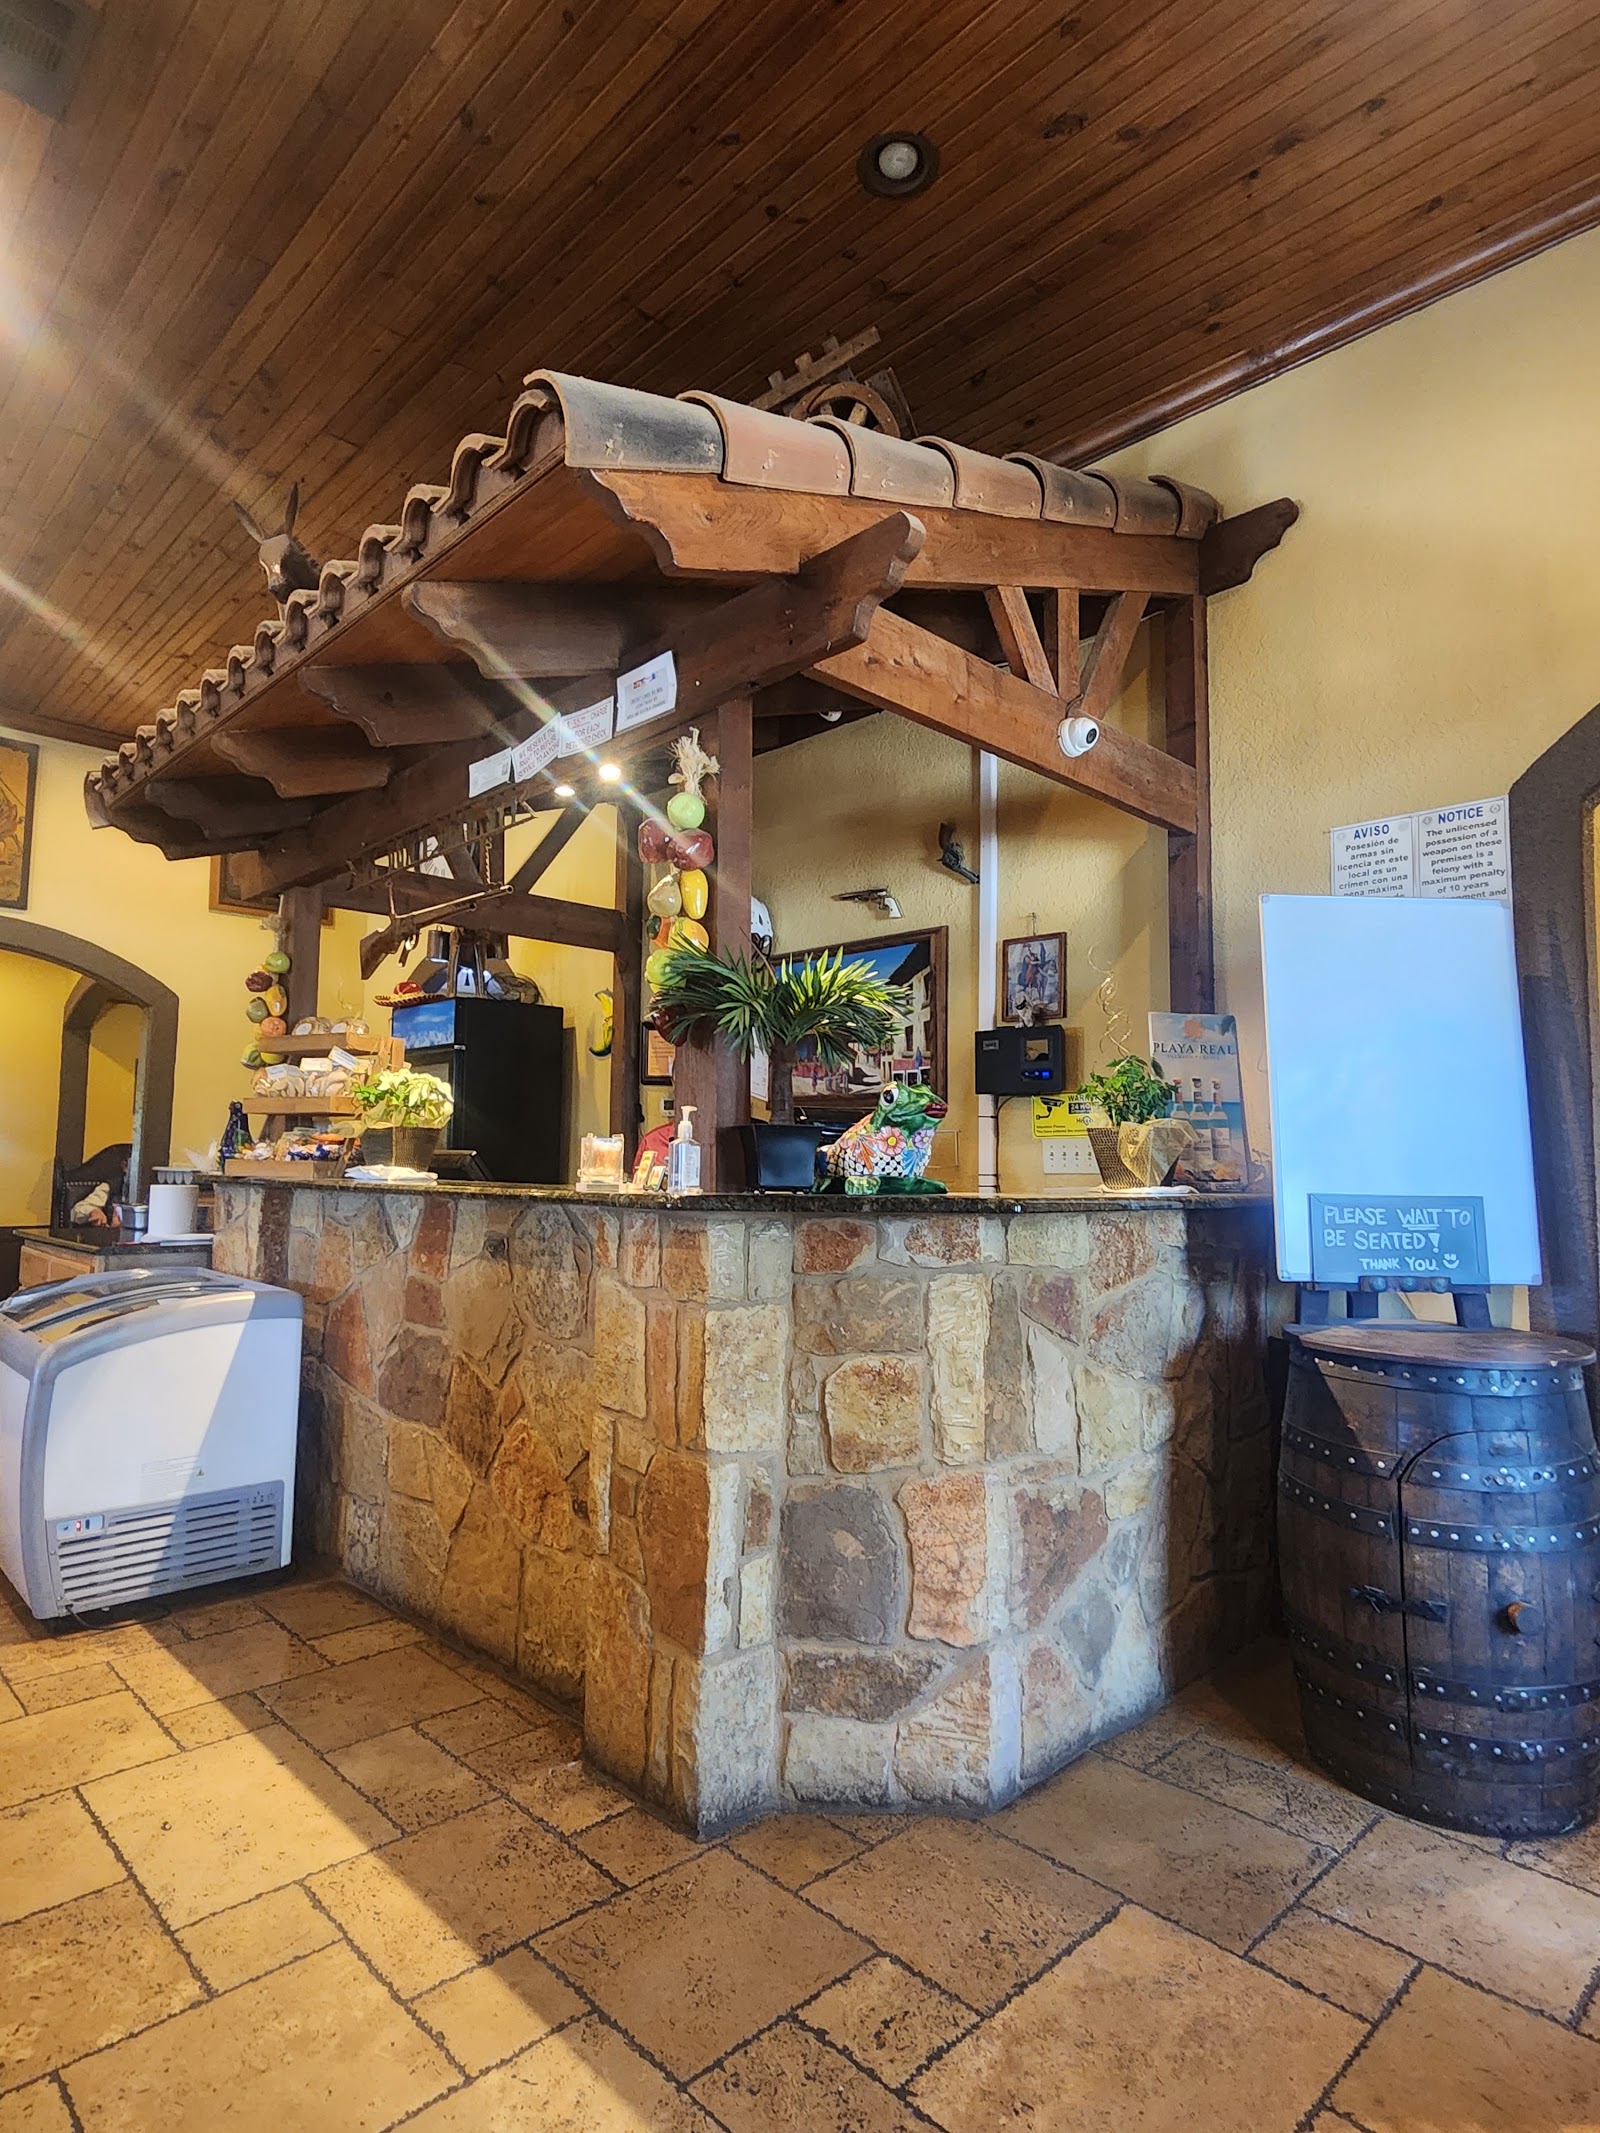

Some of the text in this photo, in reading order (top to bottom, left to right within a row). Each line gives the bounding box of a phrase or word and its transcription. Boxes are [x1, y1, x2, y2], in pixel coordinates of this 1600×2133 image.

[1438, 806, 1484, 824] NOTICE
[1353, 824, 1390, 840] AVISO
[1426, 819, 1497, 837] The unlicensed
[1345, 839, 1385, 852] Posesión
[1425, 833, 1477, 848] possession
[1350, 847, 1394, 860] armas sin
[1422, 846, 1458, 857] weapon
[1475, 839, 1502, 848] these
[1337, 860, 1372, 872] licencia
[1388, 855, 1409, 863] este
[1431, 853, 1473, 867] premises
[1348, 869, 1370, 879] local
[1432, 865, 1460, 875] felony
[1463, 861, 1484, 870] with
[1338, 880, 1369, 890] crimen
[1371, 877, 1388, 885] con
[1421, 869, 1506, 886] maximum penalty
[1367, 884, 1404, 895] máxima
[1450, 884, 1460, 892] 10
[1463, 881, 1490, 892] years
[1489, 888, 1507, 896] and
[1153, 1042, 1235, 1055] PLAYA REAL
[1323, 1206, 1471, 1229] PLEASE WAIT TO
[1323, 1229, 1441, 1253] BE SEATED!
[1359, 1257, 1401, 1271] THANK
